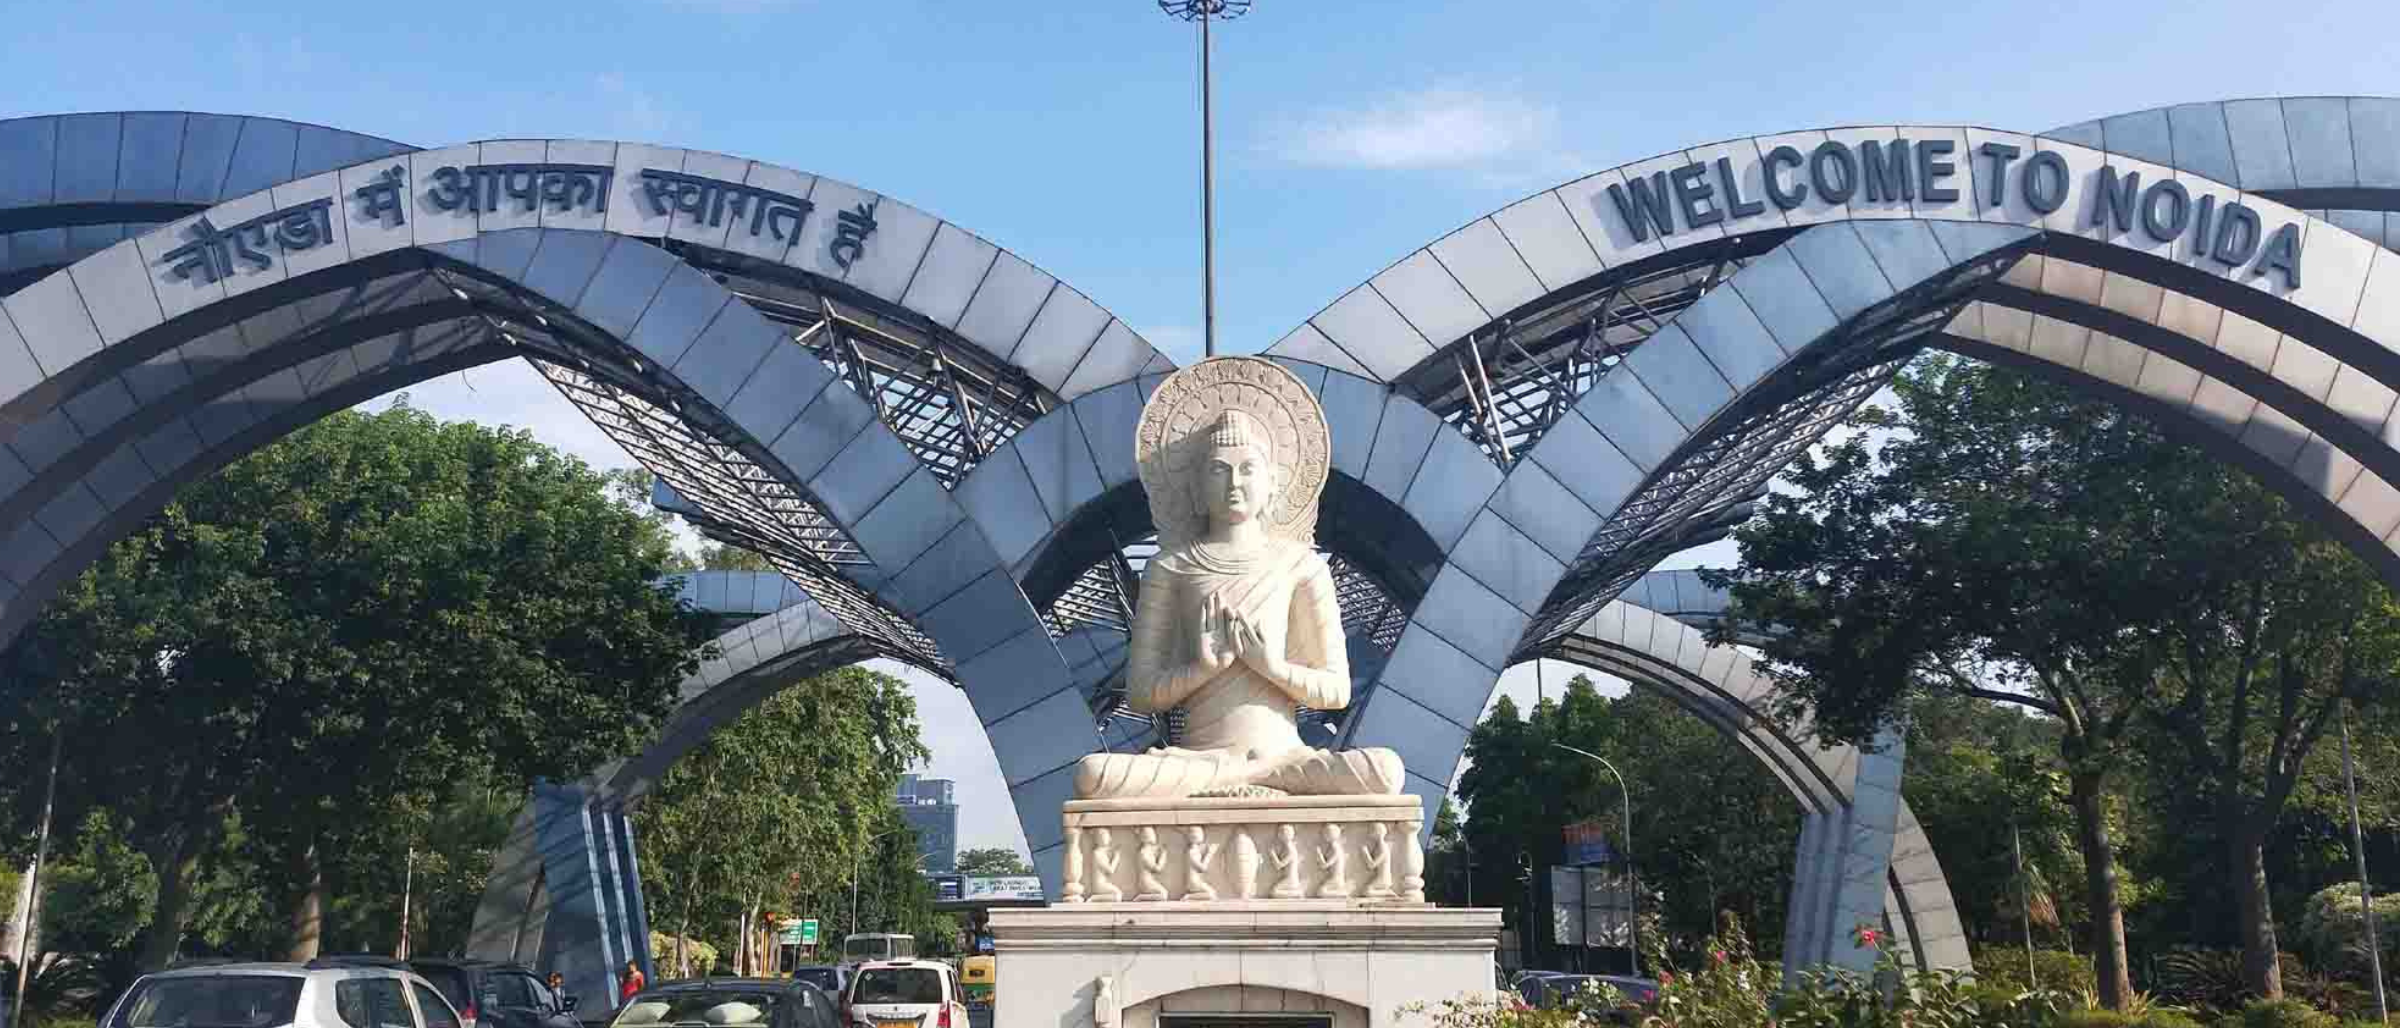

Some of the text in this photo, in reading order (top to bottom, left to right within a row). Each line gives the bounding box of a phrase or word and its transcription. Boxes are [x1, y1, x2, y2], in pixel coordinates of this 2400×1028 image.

[356, 163, 405, 227] में
[427, 162, 614, 213] आपका
[641, 167, 815, 247] स्वागत
[829, 202, 878, 268] है
[1608, 139, 2301, 290] WELCOME TO NOIDA
